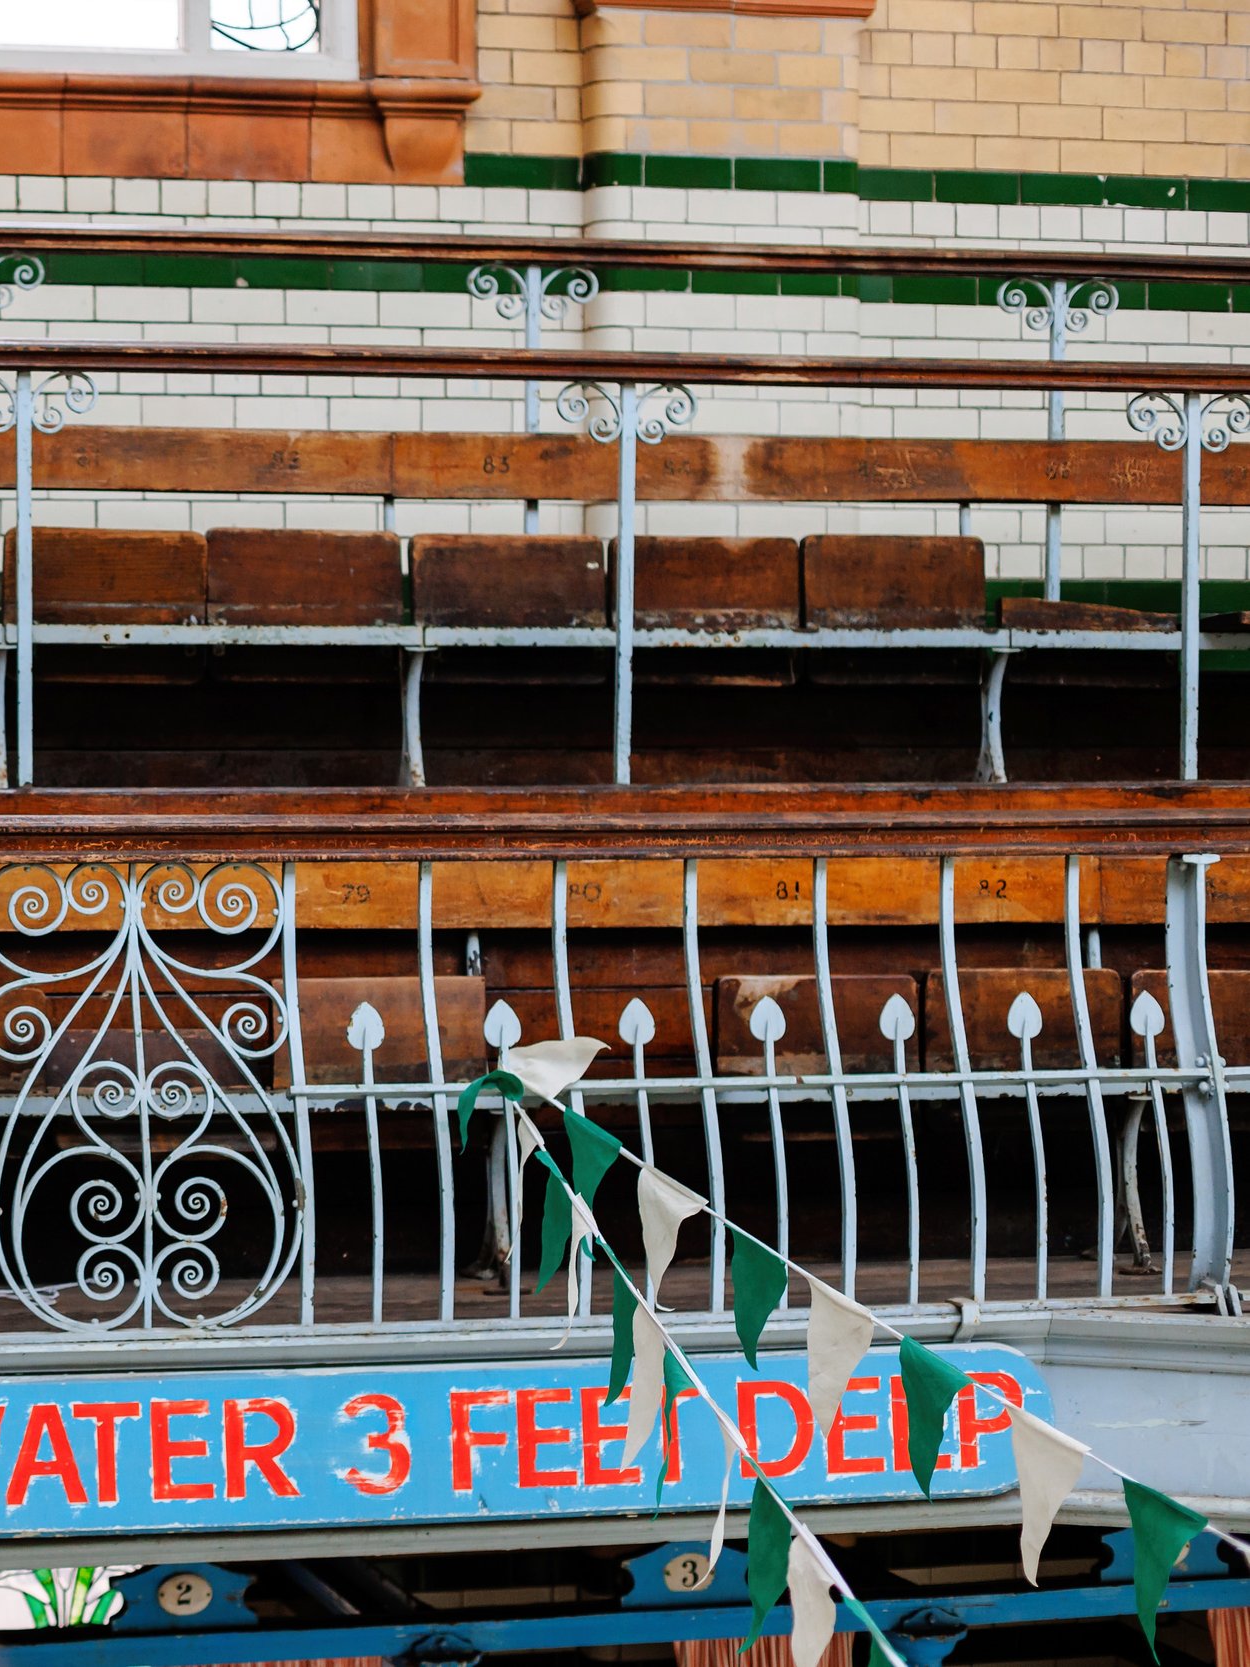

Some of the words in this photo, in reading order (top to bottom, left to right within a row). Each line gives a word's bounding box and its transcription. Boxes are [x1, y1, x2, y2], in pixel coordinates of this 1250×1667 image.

[483, 455, 510, 474] 83
[342, 884, 370, 905] 79
[776, 881, 800, 900] 81
[979, 879, 1007, 899] 82
[343, 1393, 412, 1496] 3
[450, 1383, 700, 1491] FEET
[681, 1559, 699, 1588] 3
[176, 1581, 192, 1606] 2
